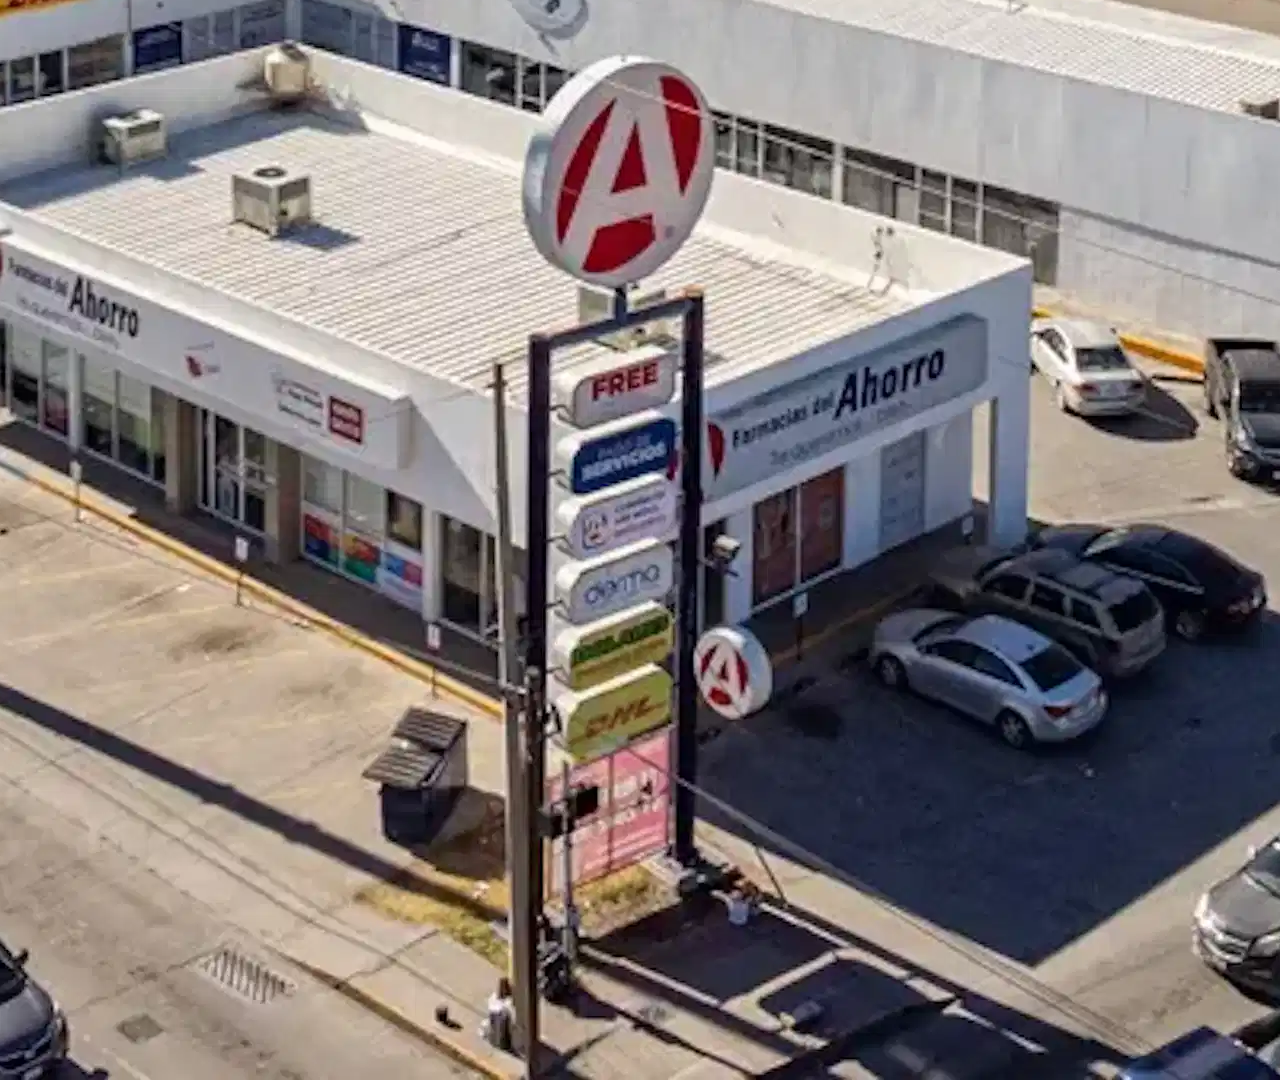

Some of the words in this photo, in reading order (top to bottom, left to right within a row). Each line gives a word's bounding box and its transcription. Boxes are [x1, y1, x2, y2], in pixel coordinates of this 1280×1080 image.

[70, 276, 139, 338] Ahorro
[593, 363, 658, 399] FREE
[732, 404, 808, 449] Farmacias
[832, 348, 945, 421] Ahorro
[581, 442, 667, 482] SERVICIOS
